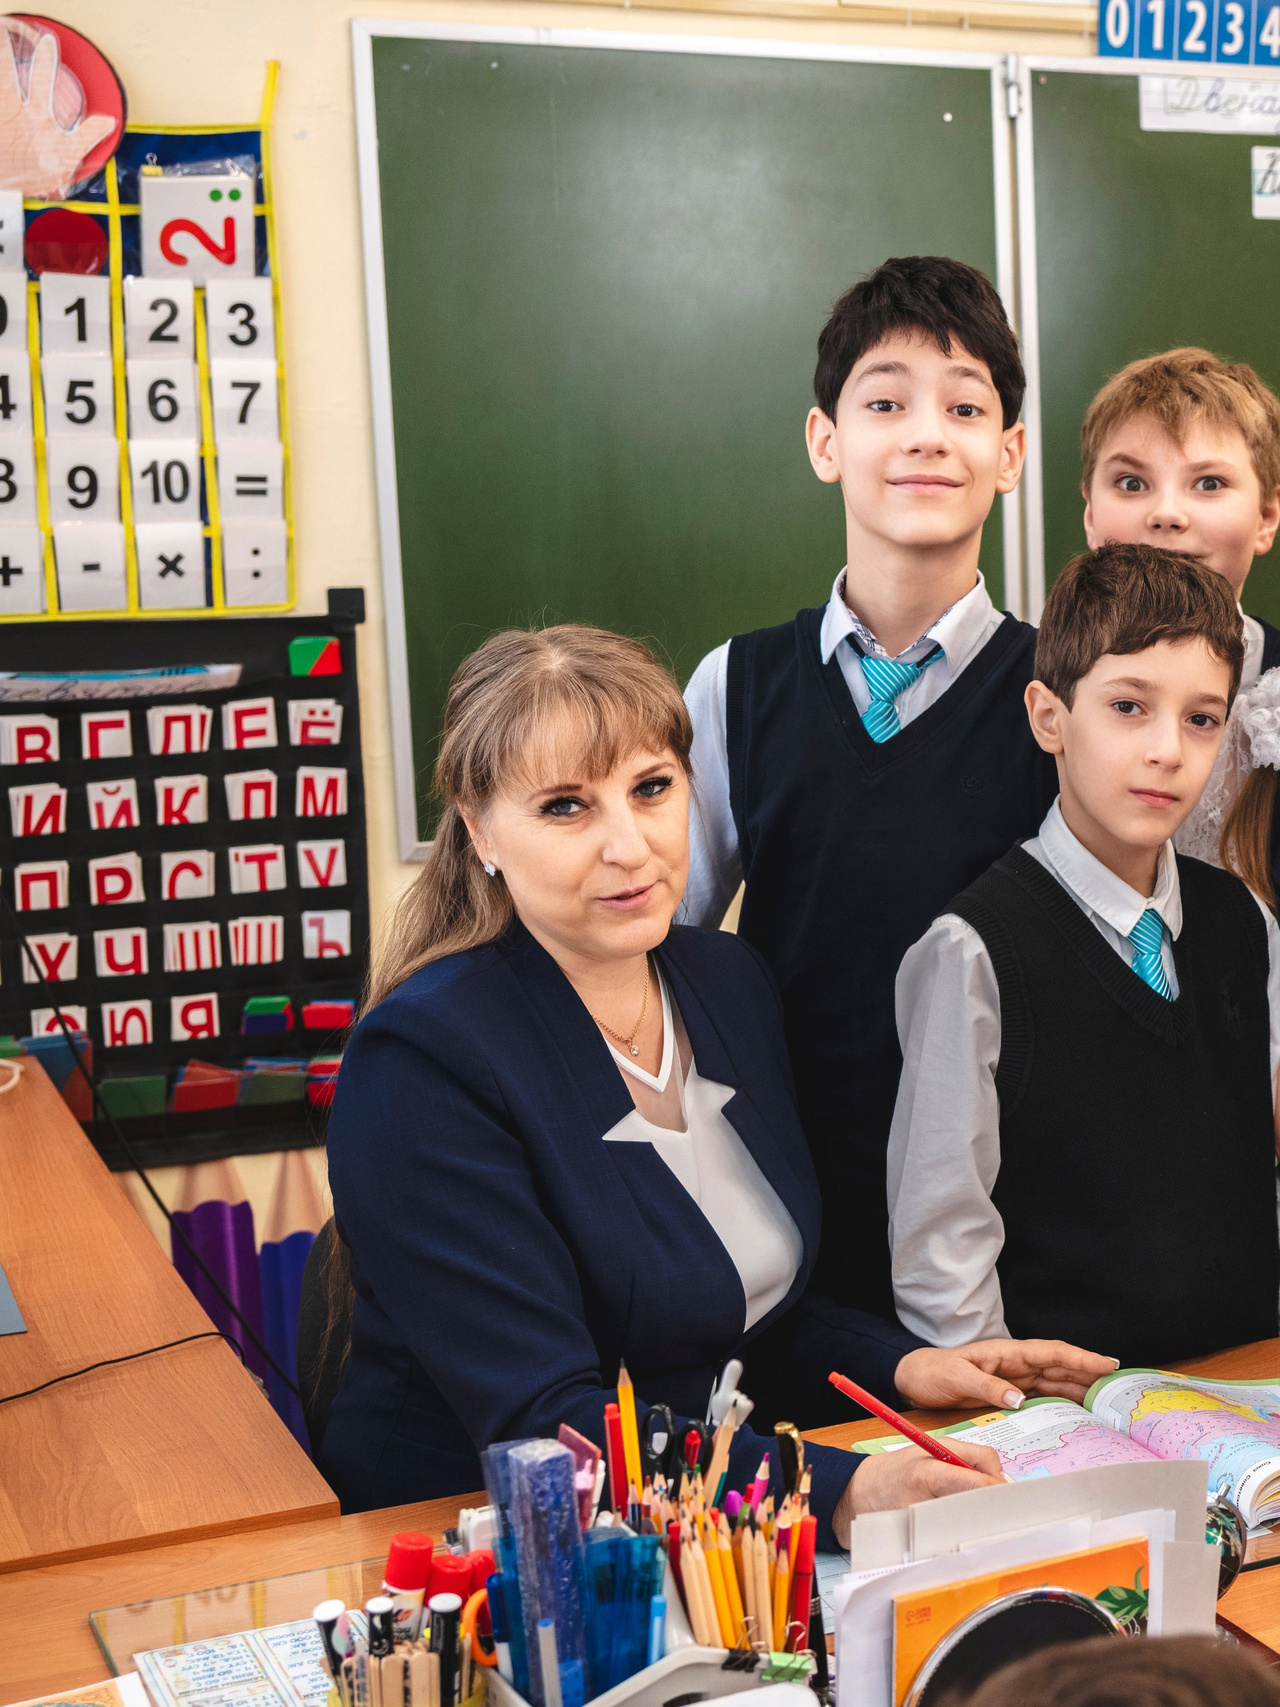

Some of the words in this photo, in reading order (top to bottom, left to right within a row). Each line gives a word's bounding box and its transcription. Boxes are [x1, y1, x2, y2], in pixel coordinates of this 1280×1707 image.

[1105, 0, 1130, 48] 0
[1147, 0, 1165, 51] 1
[1183, 0, 1207, 53] 2
[1222, 2, 1245, 56] 3
[64, 297, 88, 343] 1
[148, 298, 180, 343] 2
[227, 302, 259, 347] 3
[64, 379, 98, 425] 5
[147, 378, 180, 423] 6
[230, 381, 262, 424] 7
[66, 464, 99, 509] 9
[140, 459, 190, 504] 10
[87, 718, 126, 759] Г
[298, 709, 336, 745] Ё
[21, 793, 62, 836] И
[94, 784, 134, 829] Й
[162, 785, 200, 825] К
[301, 775, 339, 817] М
[19, 870, 60, 911] П
[94, 866, 133, 905] Р
[243, 851, 279, 891] Т
[179, 998, 216, 1039] Я
[918, 1434, 946, 1457] BRAUBERG
[217, 1669, 233, 1677] 60
